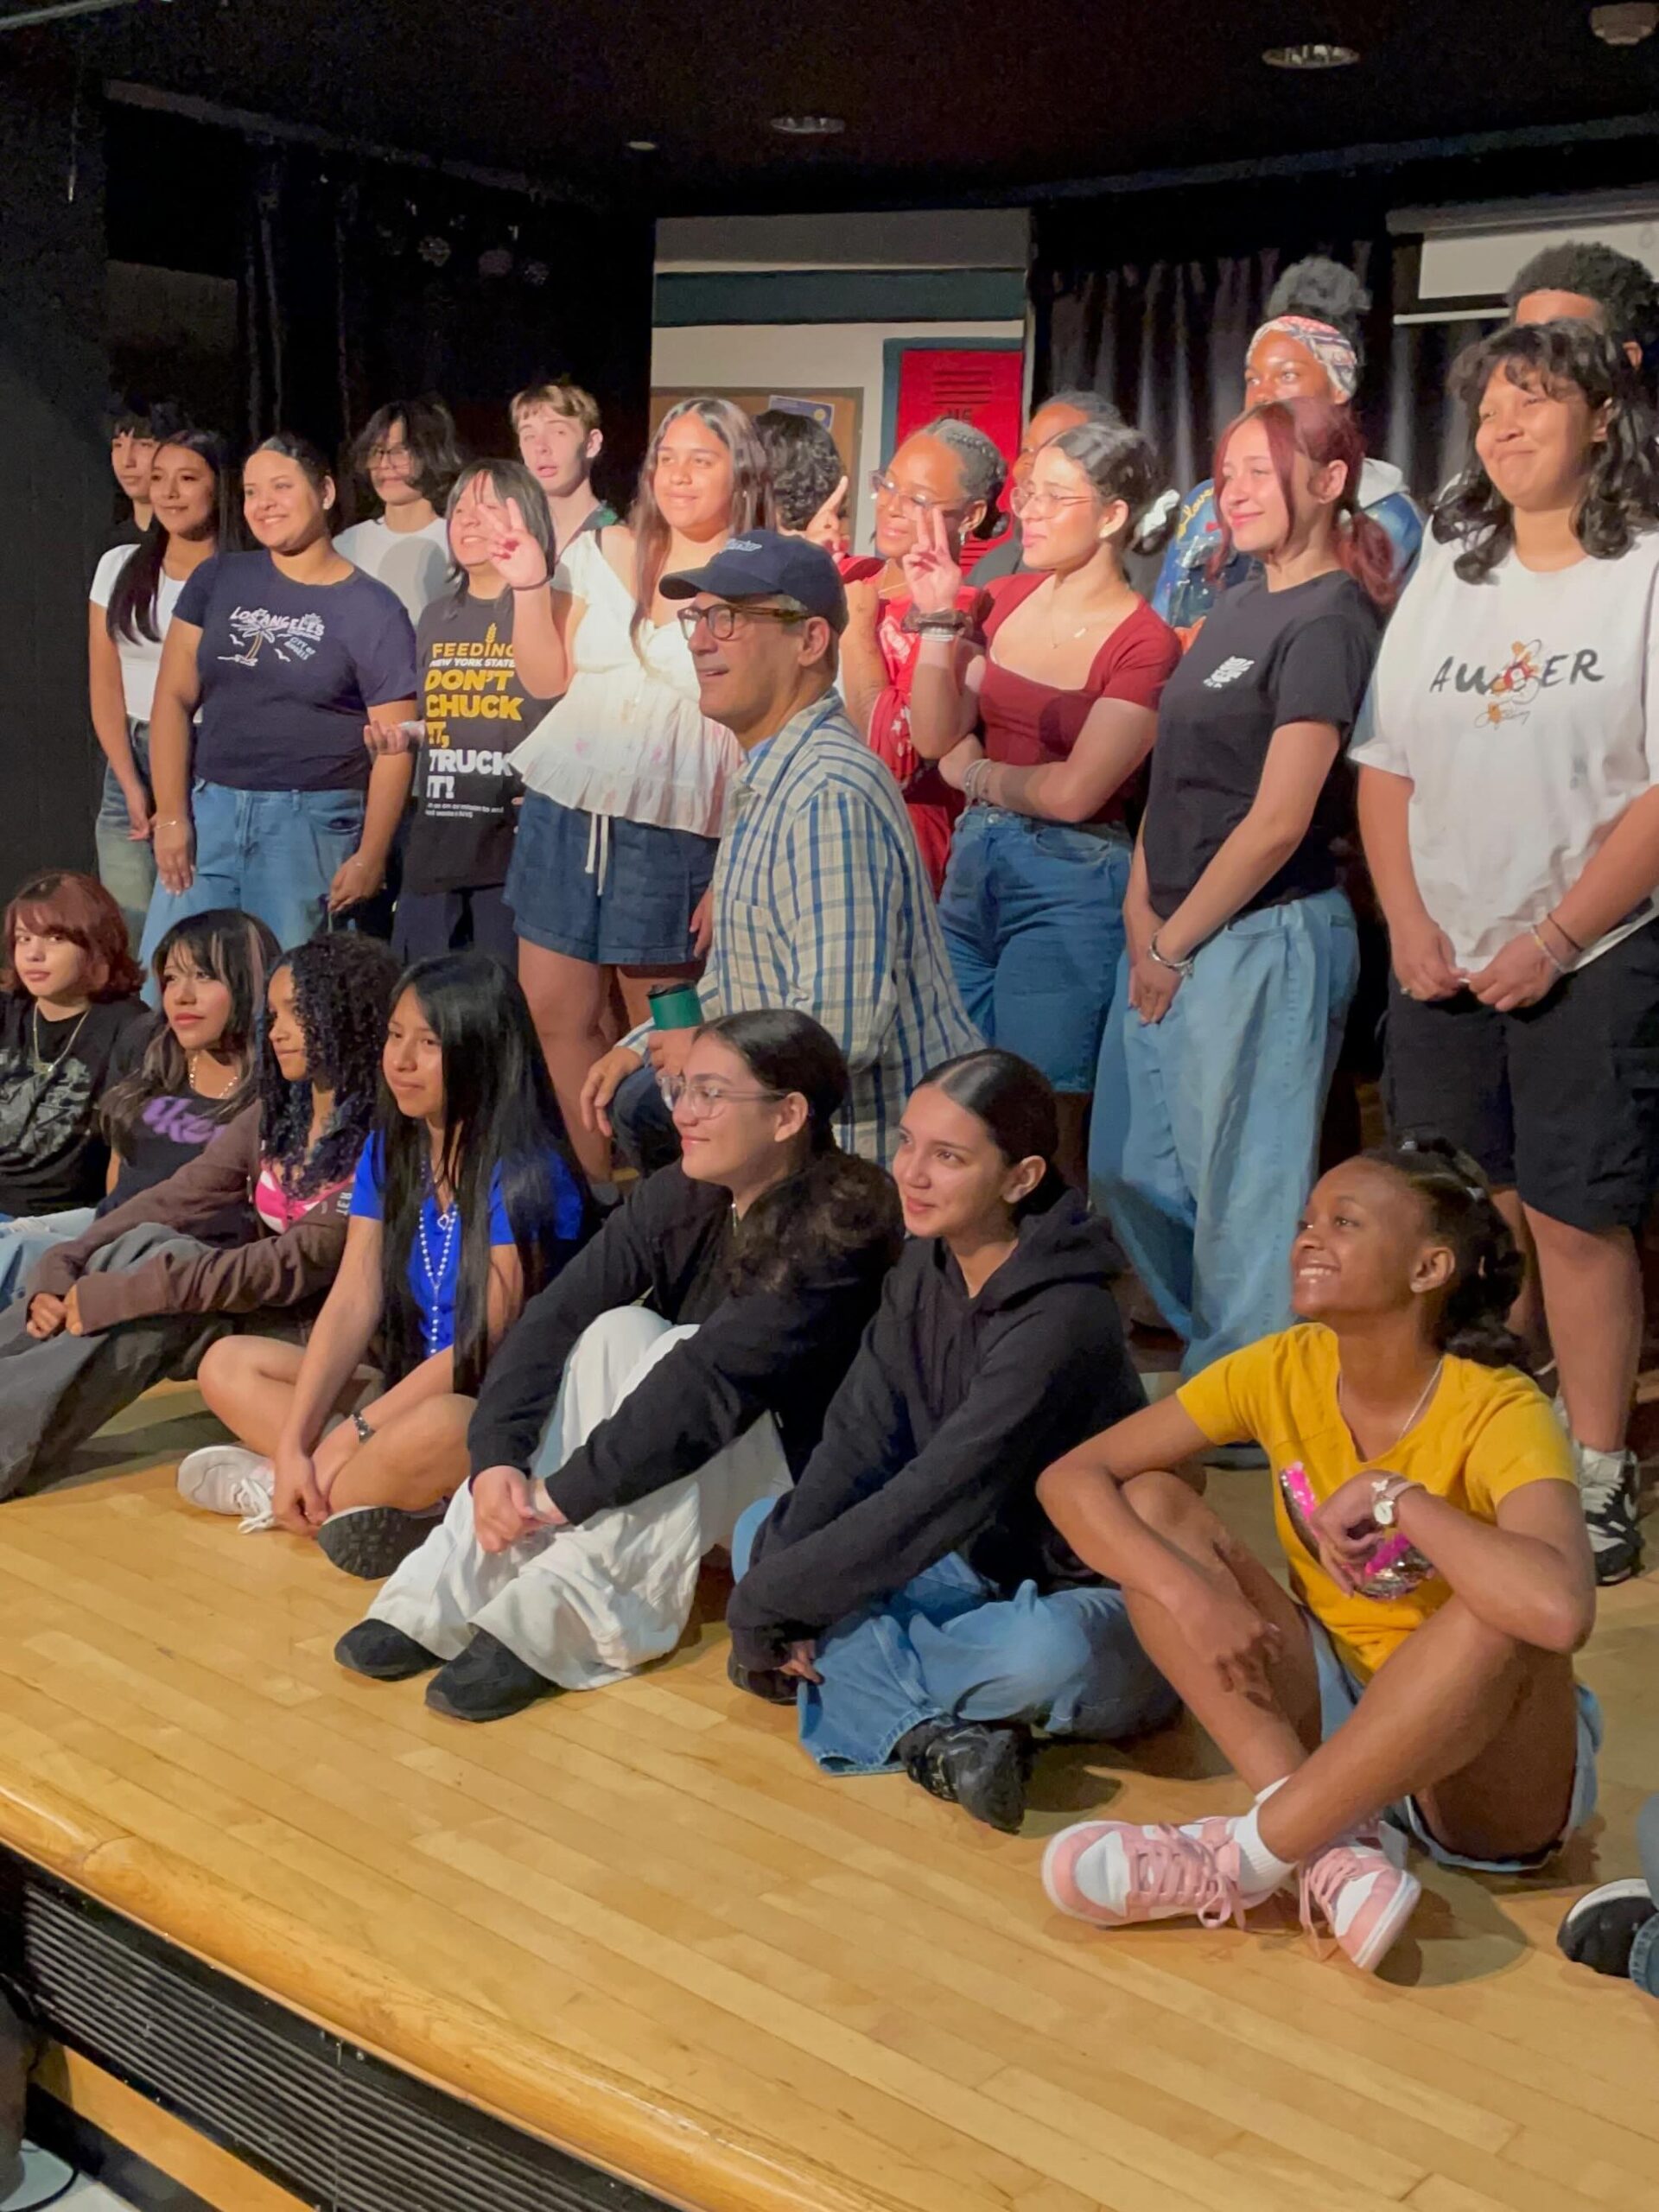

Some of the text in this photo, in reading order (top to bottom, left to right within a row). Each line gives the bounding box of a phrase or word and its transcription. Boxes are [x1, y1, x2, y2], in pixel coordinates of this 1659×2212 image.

[429, 658, 516, 668] NEW YORK STATE
[424, 669, 515, 691] DON'T
[426, 694, 524, 721] CHUCK
[429, 749, 513, 776] TRUCK
[426, 776, 455, 799] IT!
